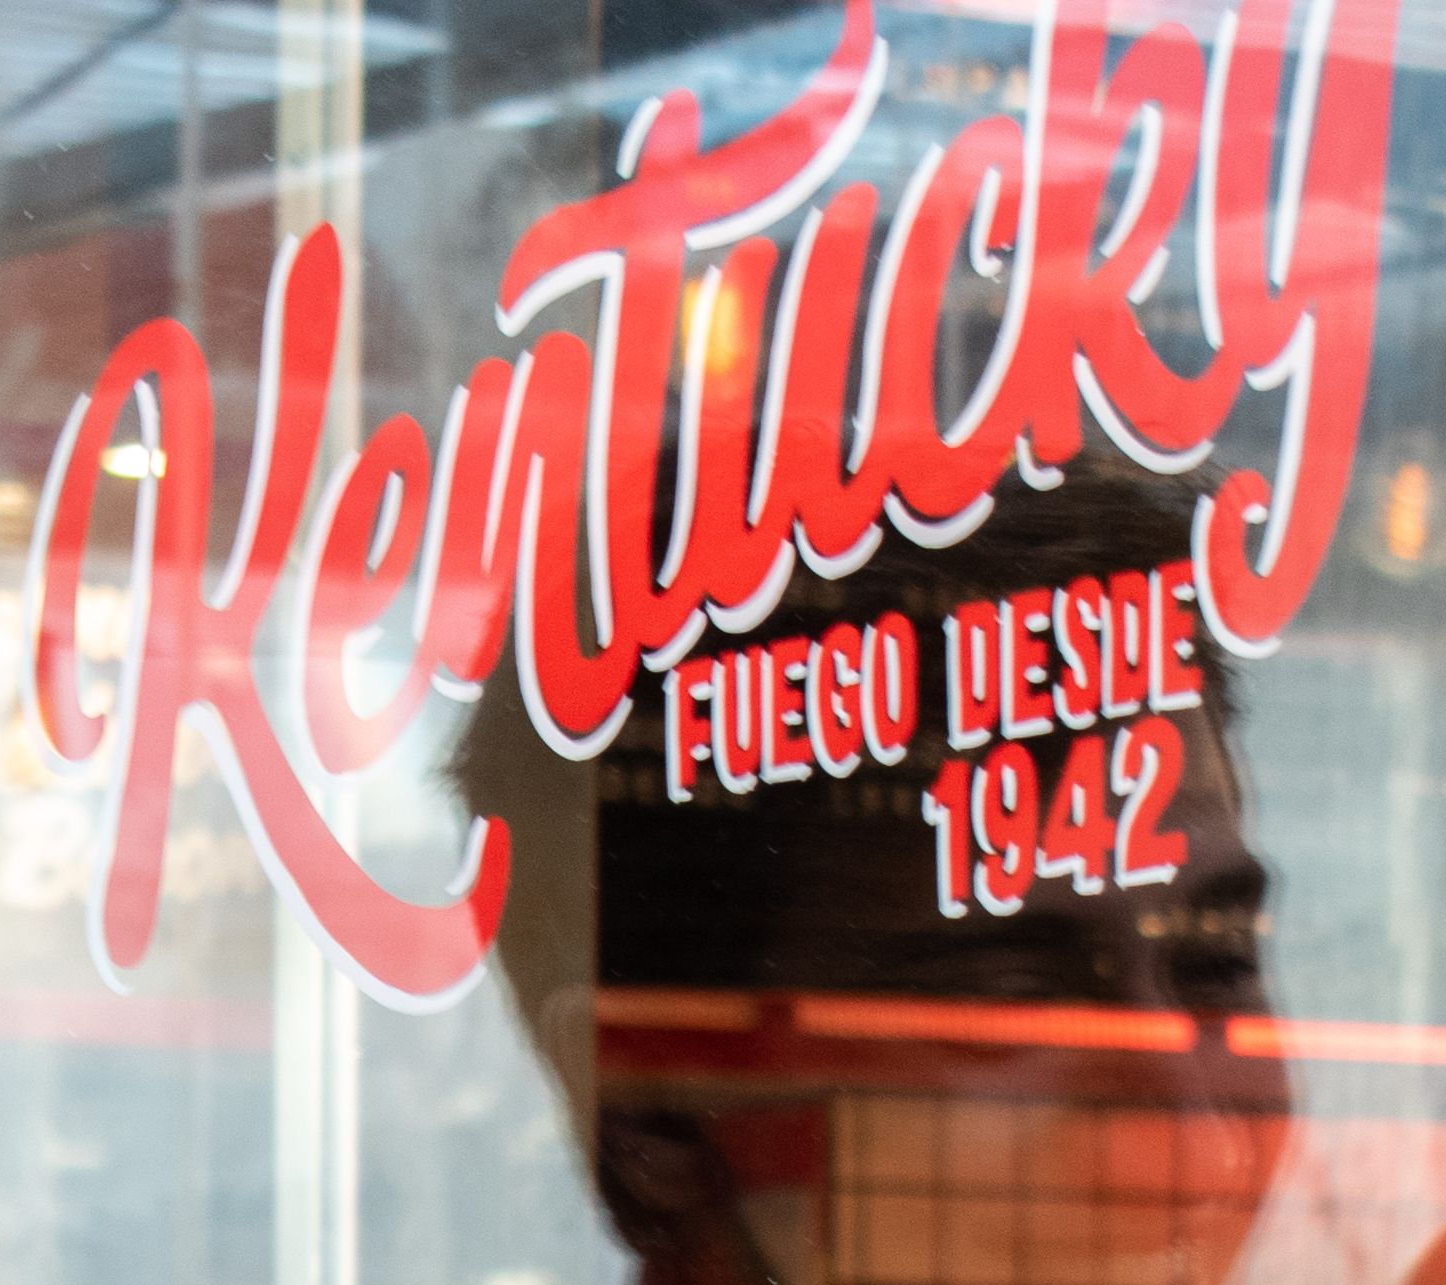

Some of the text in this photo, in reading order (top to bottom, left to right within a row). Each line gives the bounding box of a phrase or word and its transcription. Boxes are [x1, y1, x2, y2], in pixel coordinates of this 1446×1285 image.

[23, 0, 1398, 1012] Kentucky
[663, 558, 1202, 803] FUEGO DESDE
[922, 717, 1188, 918] 1942
